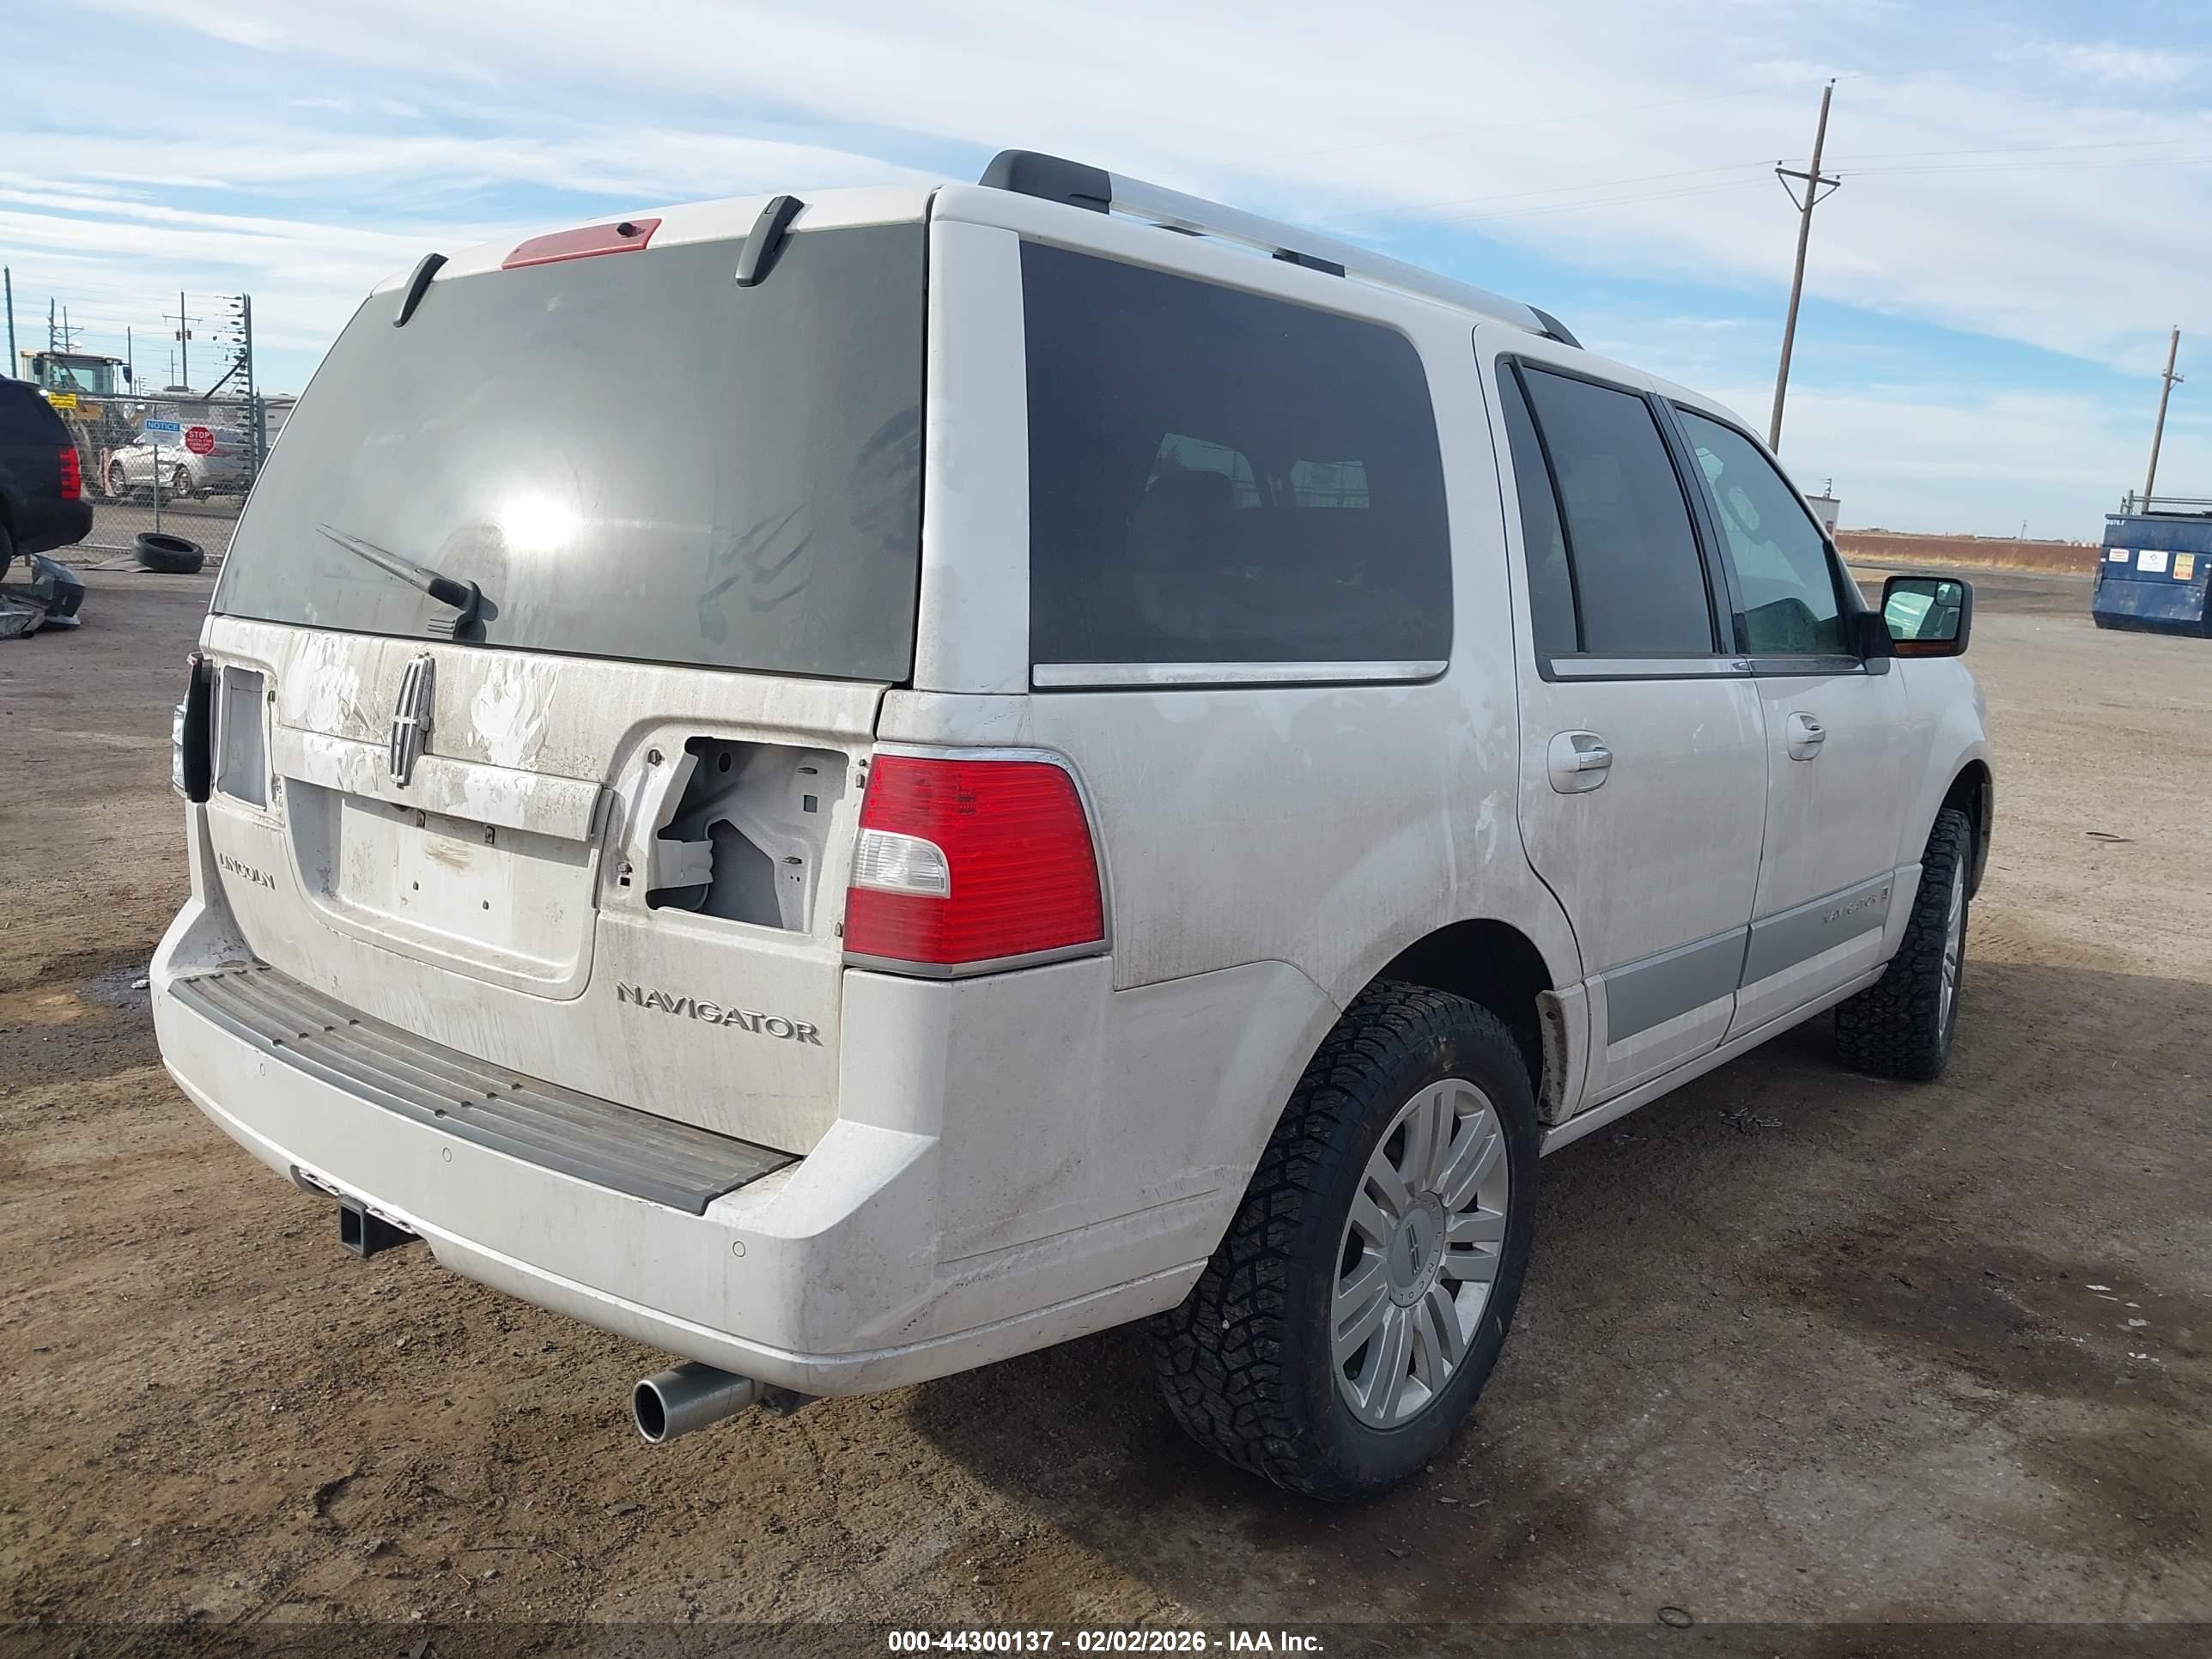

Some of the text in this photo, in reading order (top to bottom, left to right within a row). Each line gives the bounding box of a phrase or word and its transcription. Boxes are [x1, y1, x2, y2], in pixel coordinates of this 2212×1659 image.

[148, 422, 179, 430] NOTICE
[219, 852, 276, 890] LINCOLN
[616, 981, 825, 1047] NAVIGATOR
